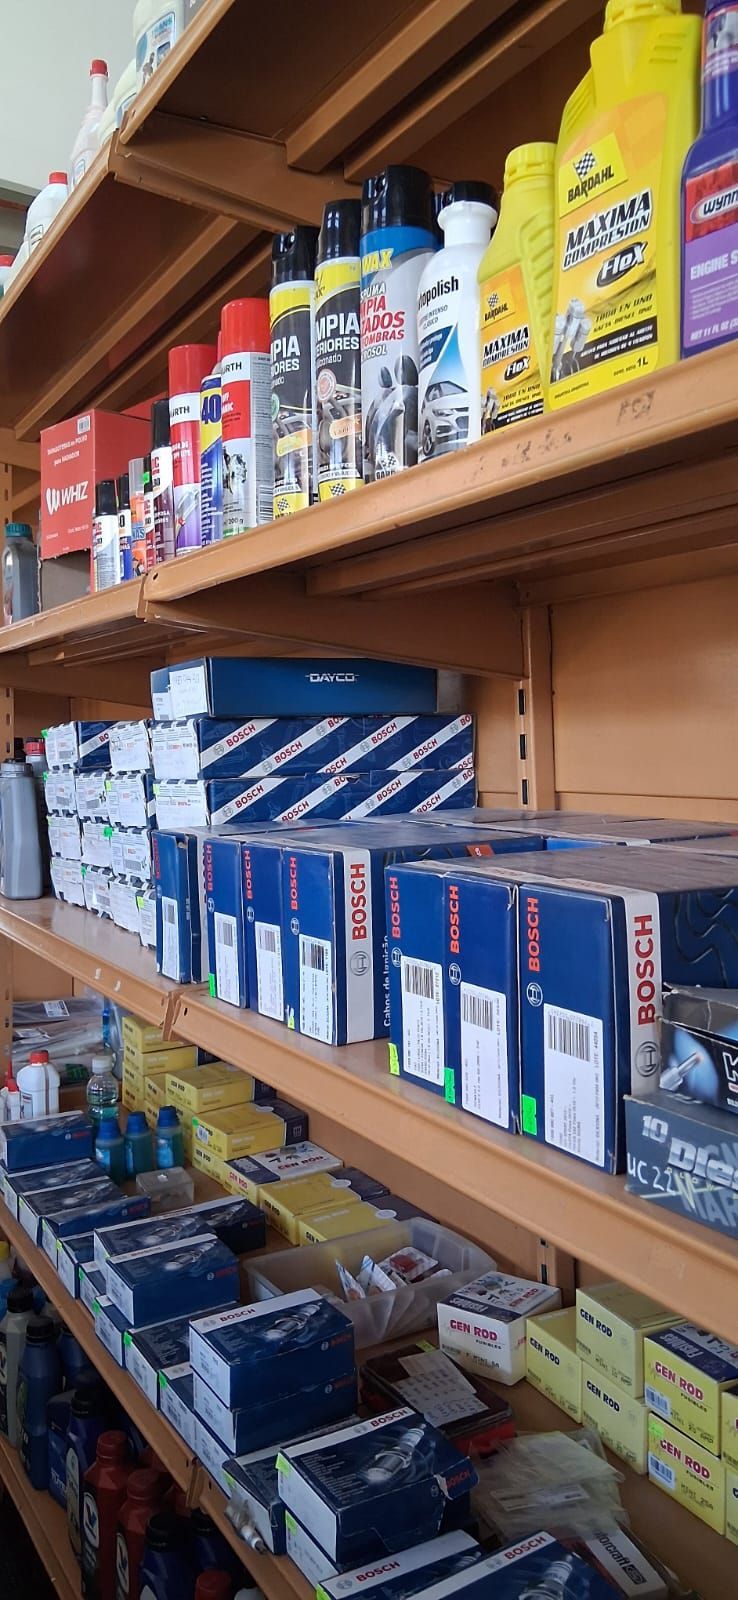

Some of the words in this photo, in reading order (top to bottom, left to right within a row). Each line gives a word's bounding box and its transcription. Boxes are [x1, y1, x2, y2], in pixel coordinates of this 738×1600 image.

[567, 165, 615, 203] BARDAHL
[563, 212, 650, 267] COMPRESION
[601, 242, 648, 281] Flex
[690, 252, 729, 280] ENGINE
[484, 303, 509, 322] BARDAHL
[637, 356, 649, 367] 1L
[202, 394, 221, 425] 40
[61, 481, 89, 506] WHIZ
[309, 673, 356, 683] DAYCO
[226, 724, 256, 748] BOSCH
[371, 722, 398, 744] BOSCH
[274, 741, 303, 764] BOSCH
[412, 739, 438, 760] BOSCH
[234, 785, 264, 809] BOSCH
[377, 779, 402, 802] BOSCH
[243, 849, 254, 899] BOSCH
[289, 857, 299, 911] BOSCH
[350, 863, 368, 940] BOSCH
[389, 877, 402, 938] BOSCH
[449, 886, 461, 954] BOSCH
[526, 898, 541, 972] BOSCH
[634, 915, 657, 1025] BOSCH
[641, 1115, 669, 1143] 10
[219, 1307, 256, 1323] BOSCH
[580, 1308, 595, 1325] GEN
[596, 1318, 613, 1338] ROD
[449, 1319, 471, 1333] GEN
[473, 1326, 498, 1341] ROD
[530, 1337, 543, 1353] GEN
[544, 1347, 560, 1365] ROD
[655, 1361, 676, 1384] GEN
[679, 1376, 704, 1401] ROD
[586, 1380, 601, 1398] GEN
[602, 1393, 620, 1412] ROD
[370, 1408, 409, 1429] BOSCH
[660, 1440, 682, 1461] GEN
[685, 1454, 710, 1479] ROD
[445, 1470, 471, 1491] BOSCH
[505, 1536, 547, 1561] BOSCH
[355, 1560, 401, 1583] BOSCH
